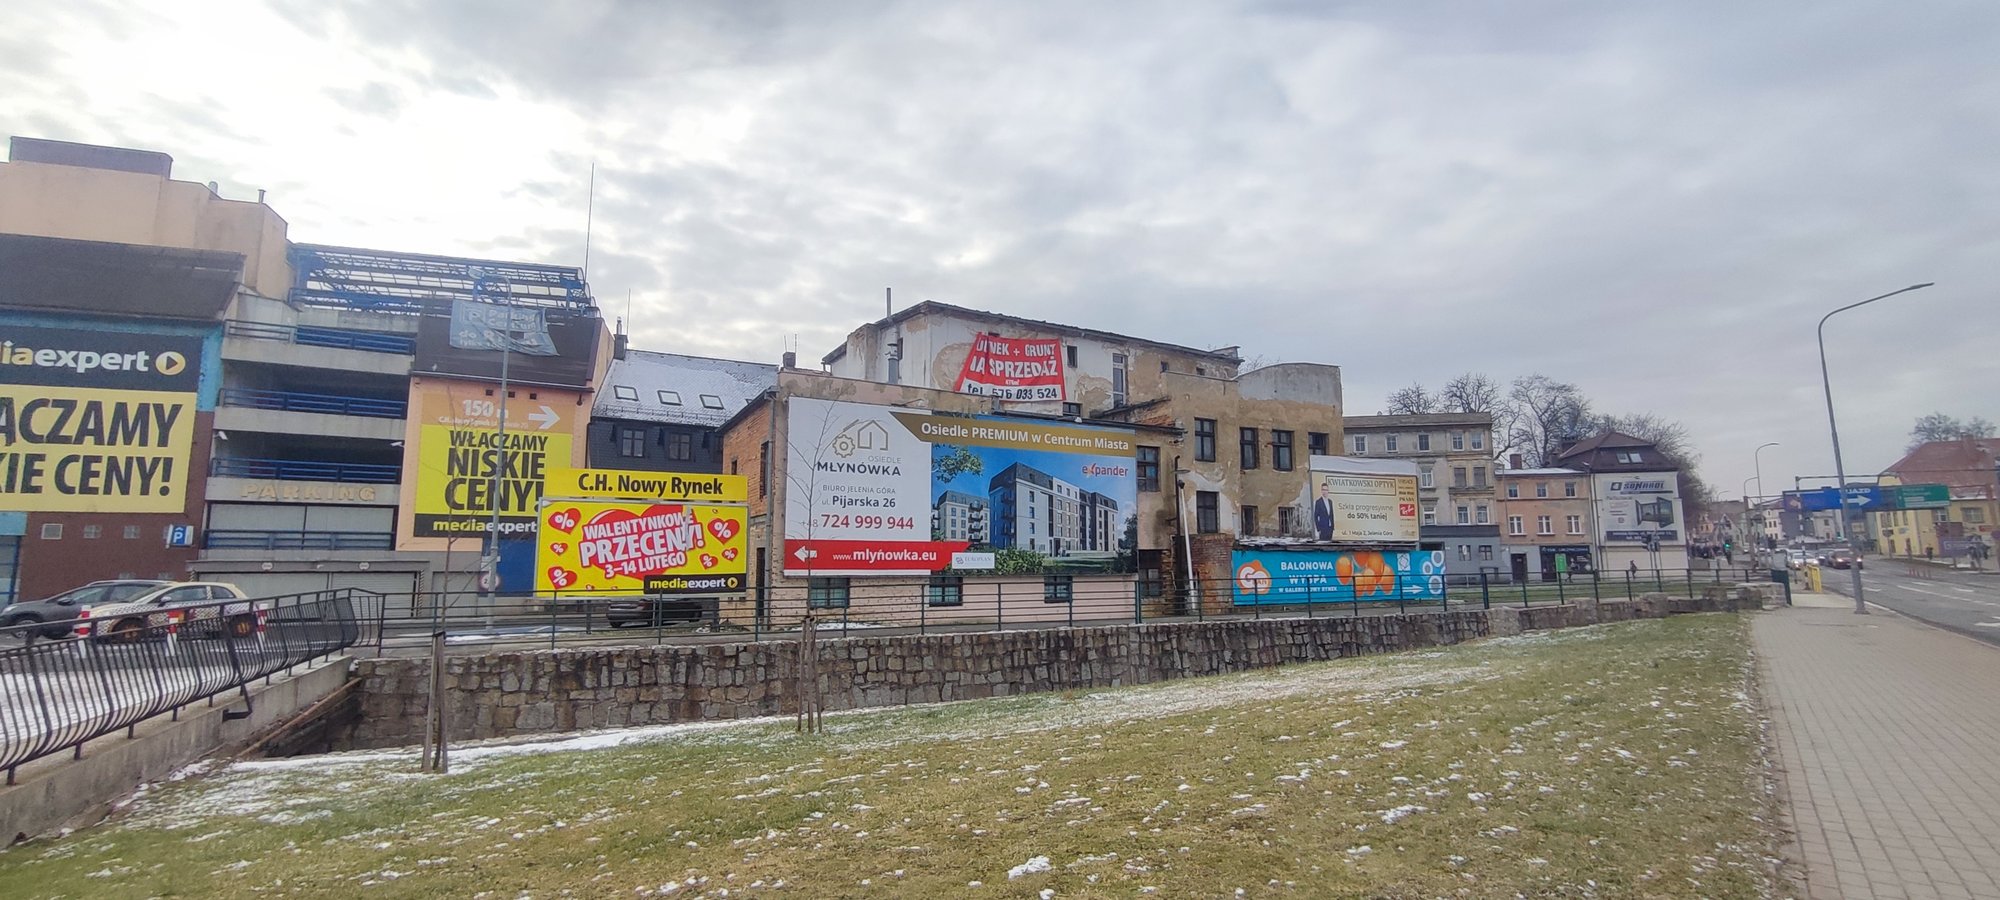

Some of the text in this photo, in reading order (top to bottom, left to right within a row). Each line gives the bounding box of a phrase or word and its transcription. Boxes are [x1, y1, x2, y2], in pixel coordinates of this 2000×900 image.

[0, 340, 149, 373] iaexpert
[1025, 344, 1056, 357] GRUNT
[989, 356, 1058, 378] SPRZEDAŻ
[1016, 389, 1033, 399] 033
[1036, 388, 1057, 399] 524
[463, 399, 494, 417] 150
[449, 430, 548, 451] WŁĄCZAMY
[921, 422, 1129, 450] Osiedle PREMIUM w Centrum Miasta
[447, 448, 546, 479] NISKIE
[817, 461, 901, 476] MŁYNÓWKA
[868, 456, 901, 464] OSIEDLE
[54, 454, 174, 497] CENY!
[1328, 478, 1373, 488] KWIATKOWSKI
[1374, 480, 1394, 489] OPTYK
[240, 482, 376, 502] PARKING
[578, 473, 723, 497] C.H. Nowy Rynek
[823, 484, 896, 494] BIURO JELENIA GÓRA
[445, 478, 544, 512] CENY!
[832, 495, 879, 509] Pijarska
[882, 498, 896, 508] 26
[433, 519, 537, 534] mediaexpert
[821, 514, 850, 528] 724
[855, 515, 882, 529] 999
[887, 516, 914, 530] 944
[580, 524, 704, 567] PRZECENY!
[638, 552, 686, 573] LUTEGO
[1281, 562, 1334, 571] BALONOWA
[650, 577, 726, 591] mediaexpert
[1289, 575, 1327, 584] WYSPA
